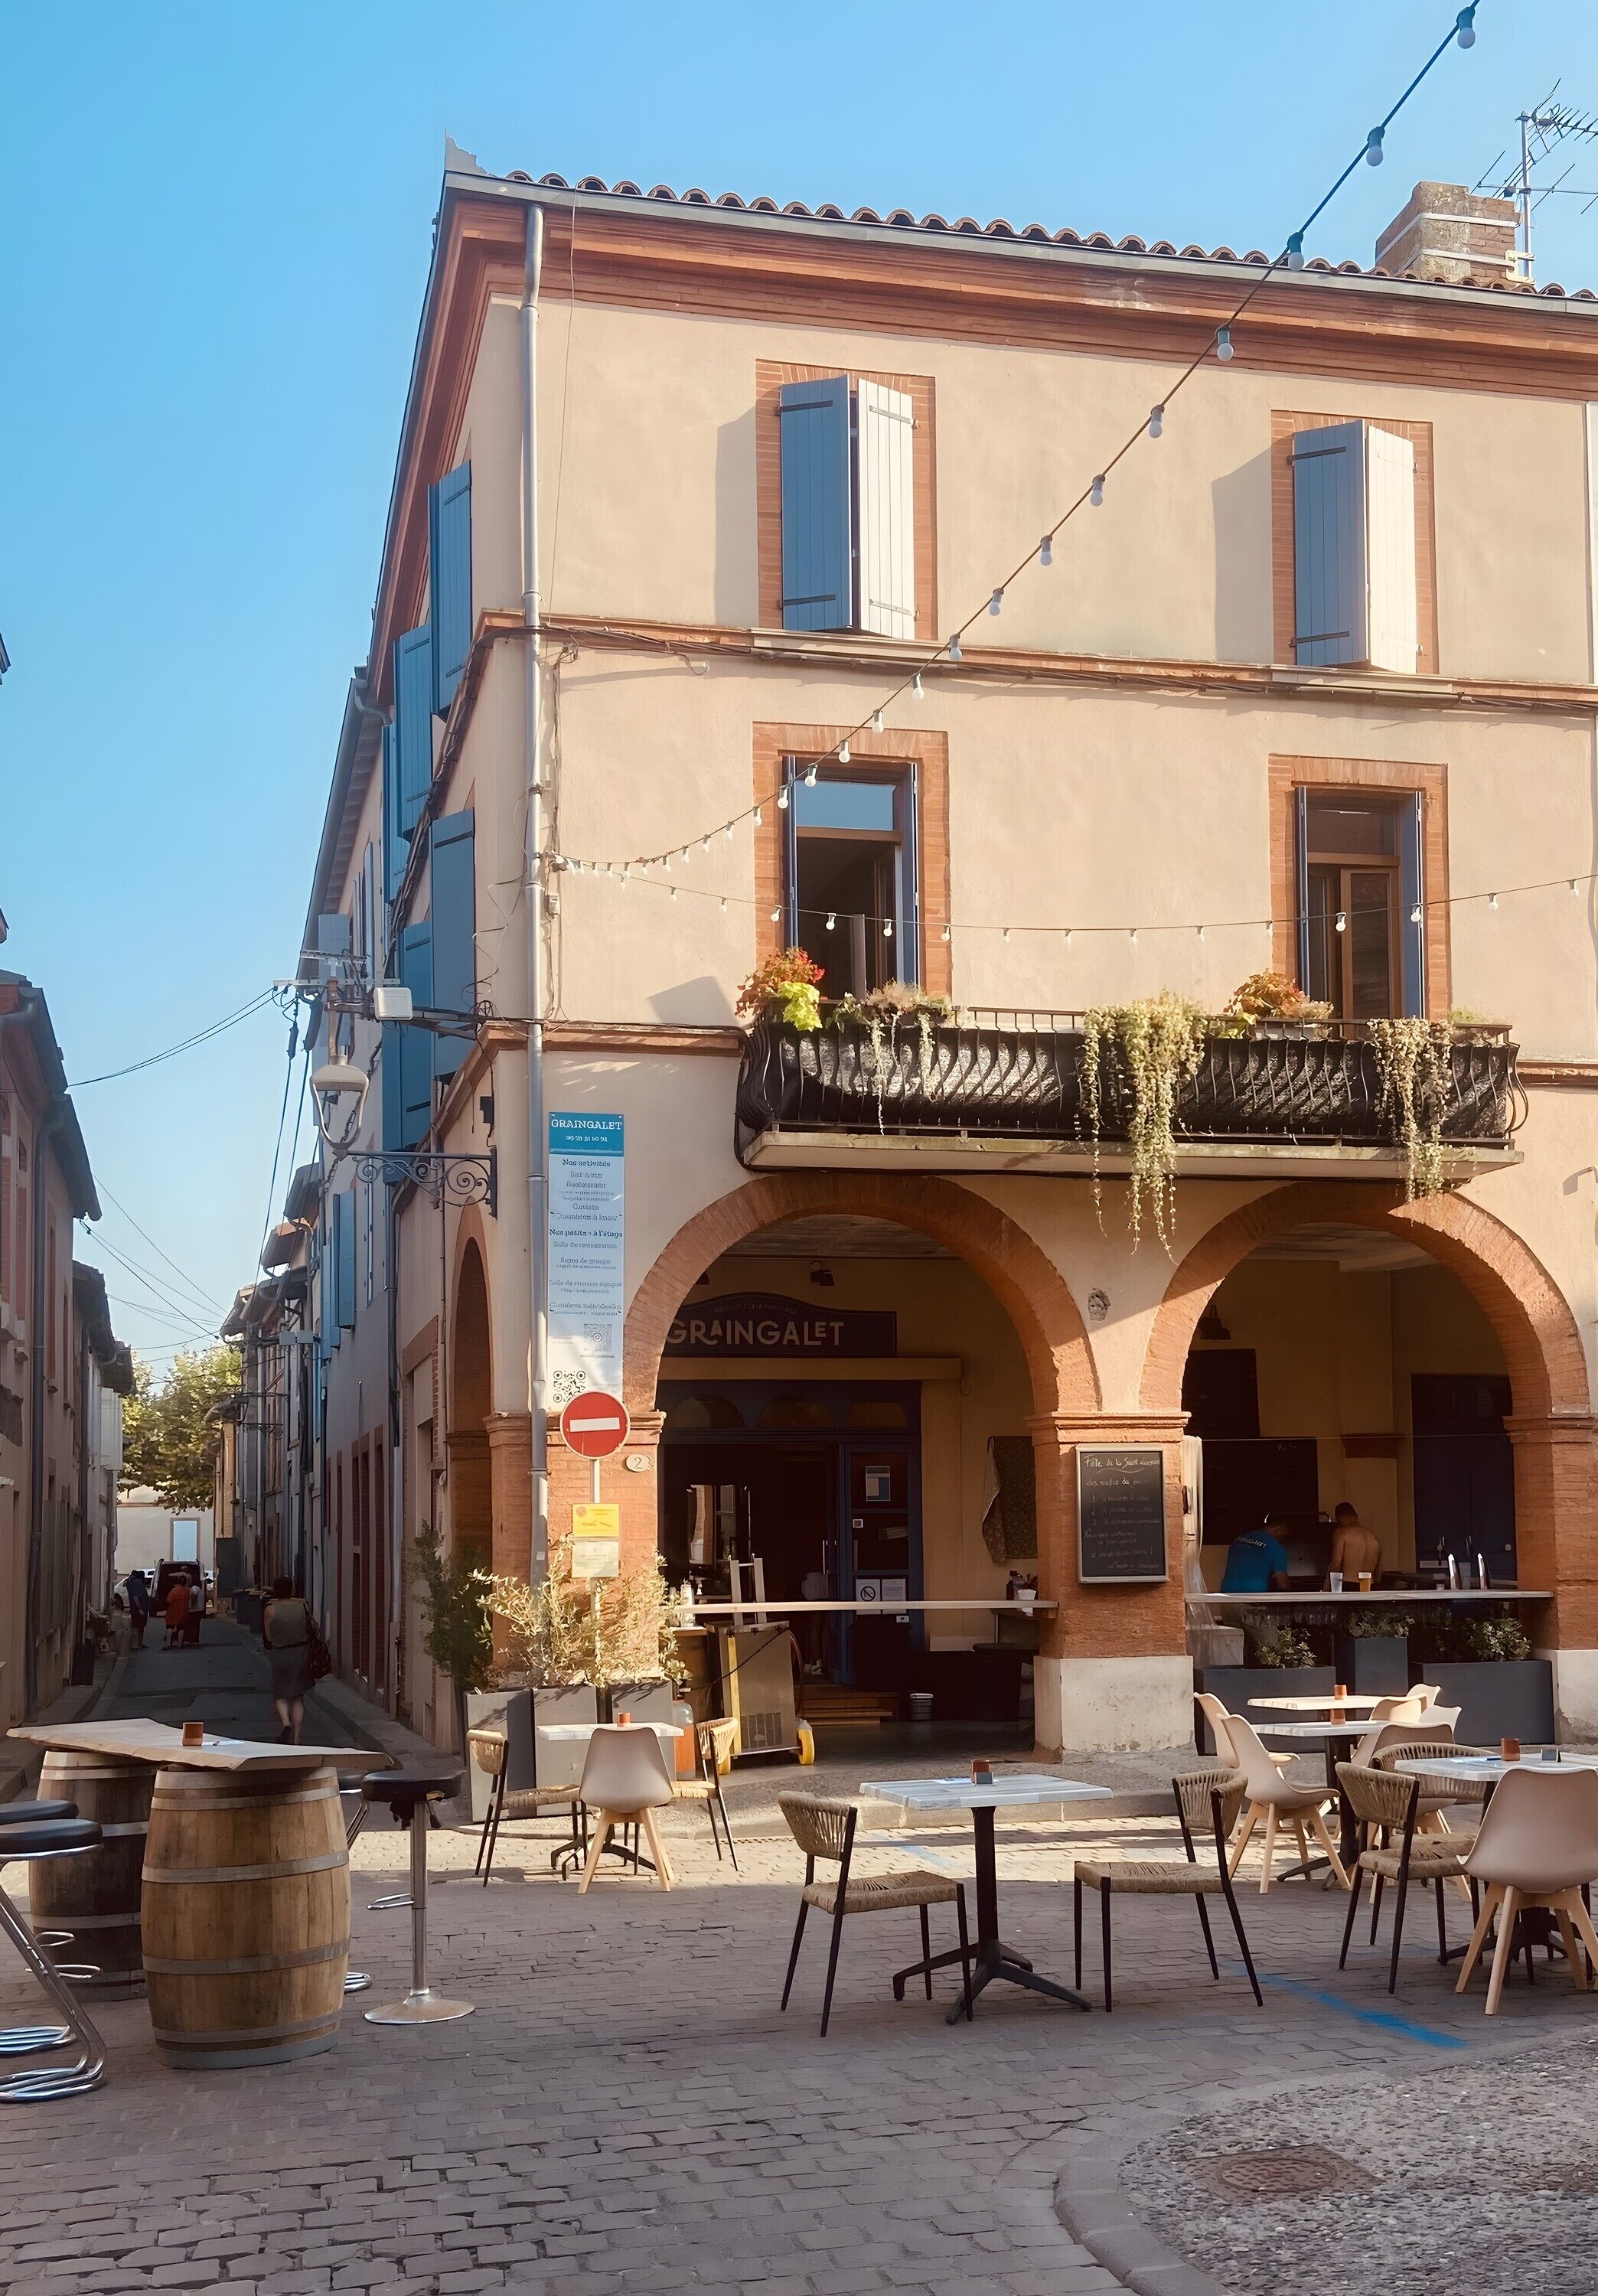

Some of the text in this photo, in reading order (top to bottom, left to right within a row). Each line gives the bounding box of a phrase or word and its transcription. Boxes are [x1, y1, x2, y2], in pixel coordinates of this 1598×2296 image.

[551, 1119, 622, 1130] GRAINGALET
[666, 1319, 843, 1345] GRAINGALET
[634, 1456, 643, 1469] 2
